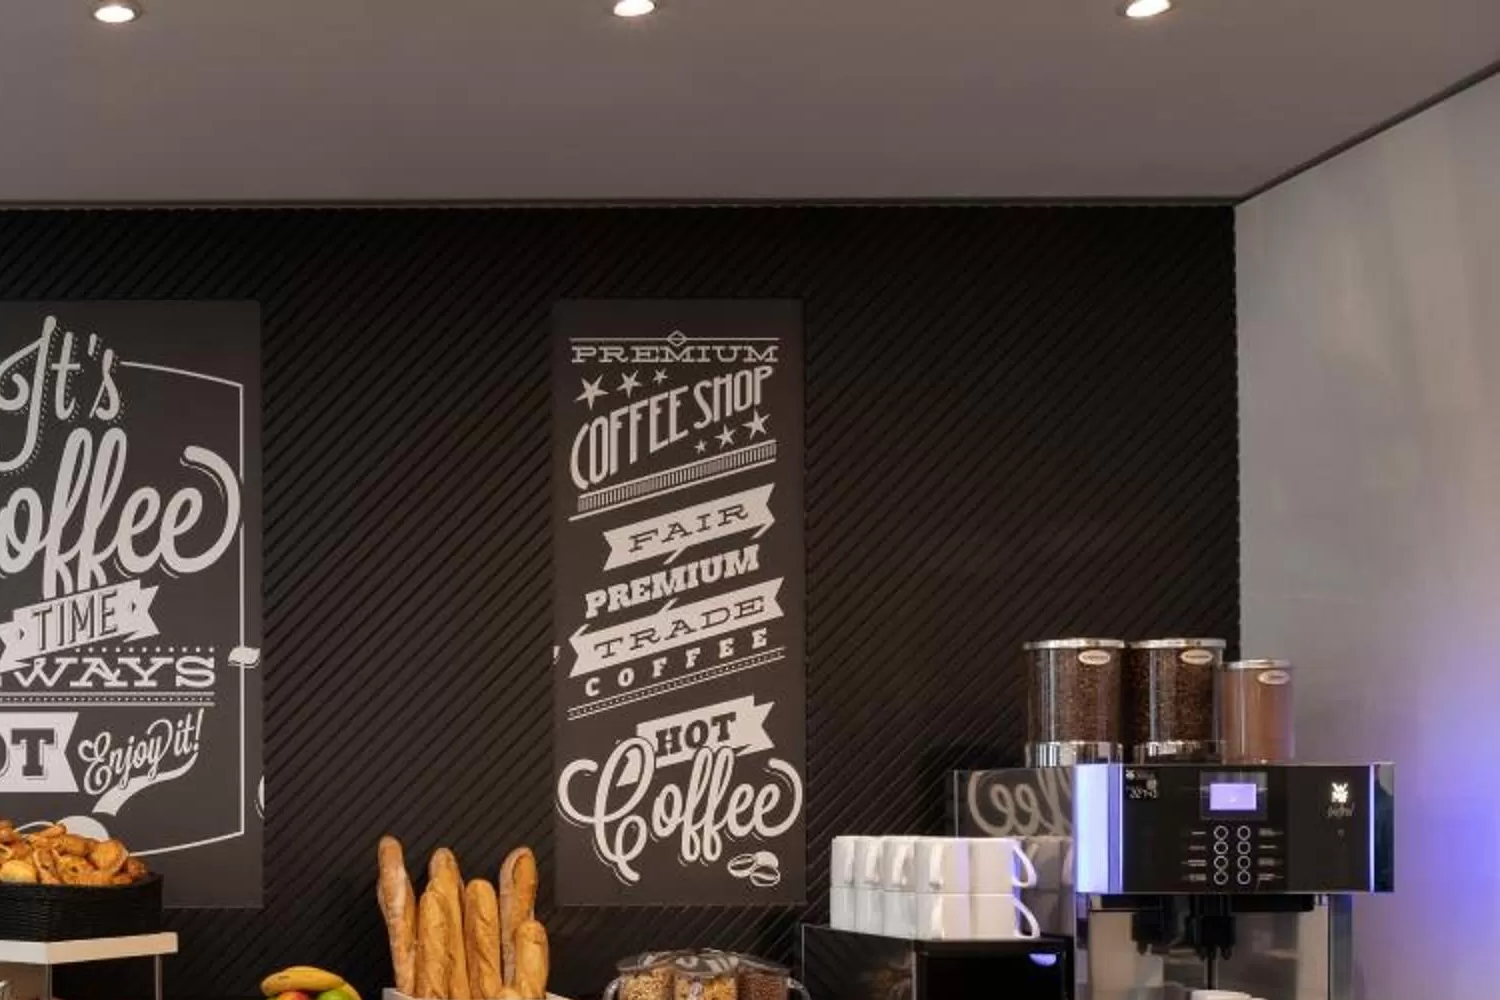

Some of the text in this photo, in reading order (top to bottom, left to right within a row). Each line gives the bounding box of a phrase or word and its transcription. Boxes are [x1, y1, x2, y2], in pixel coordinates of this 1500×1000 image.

[571, 345, 779, 363] PREMIUM
[570, 365, 773, 490] COFFEE SHOP
[628, 503, 749, 553] FAIR
[585, 544, 760, 619] PREMIUM
[32, 591, 118, 650] TIME
[593, 596, 765, 659] TRADE
[585, 627, 768, 697] COFFEE
[77, 707, 204, 795] Enjoy it!
[655, 711, 737, 756] HOT
[557, 737, 803, 882] Coffee
